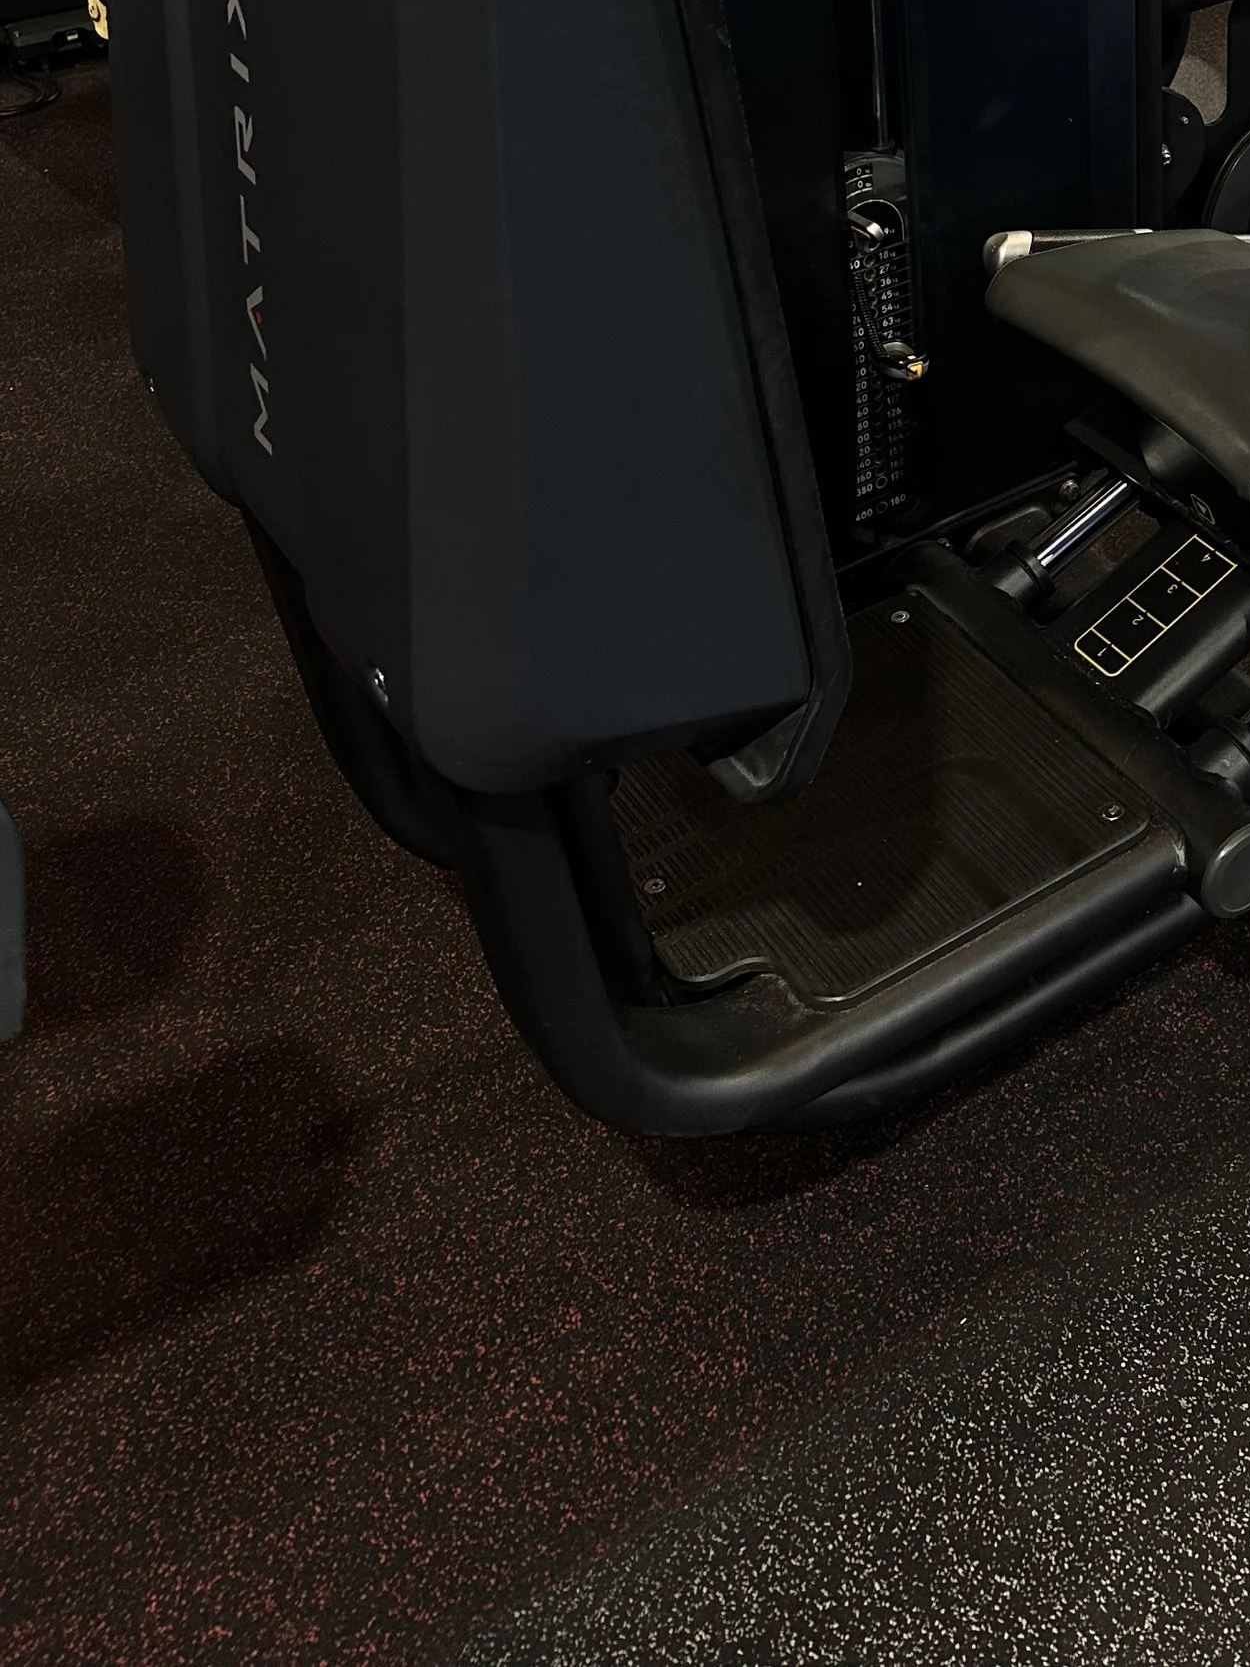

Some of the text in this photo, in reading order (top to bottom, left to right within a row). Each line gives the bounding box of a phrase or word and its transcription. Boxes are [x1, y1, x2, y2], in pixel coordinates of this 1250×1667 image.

[879, 263, 890, 274] 27
[880, 276, 892, 287] 36
[881, 290, 893, 300] 45
[882, 303, 893, 314] 54
[882, 316, 894, 327] 63
[856, 483, 873, 497] 380
[890, 493, 906, 506] 180
[855, 508, 873, 522] 400
[1200, 552, 1212, 563] 4
[1167, 584, 1179, 594] 3
[1132, 614, 1144, 626] 2
[1096, 647, 1107, 657] 1
